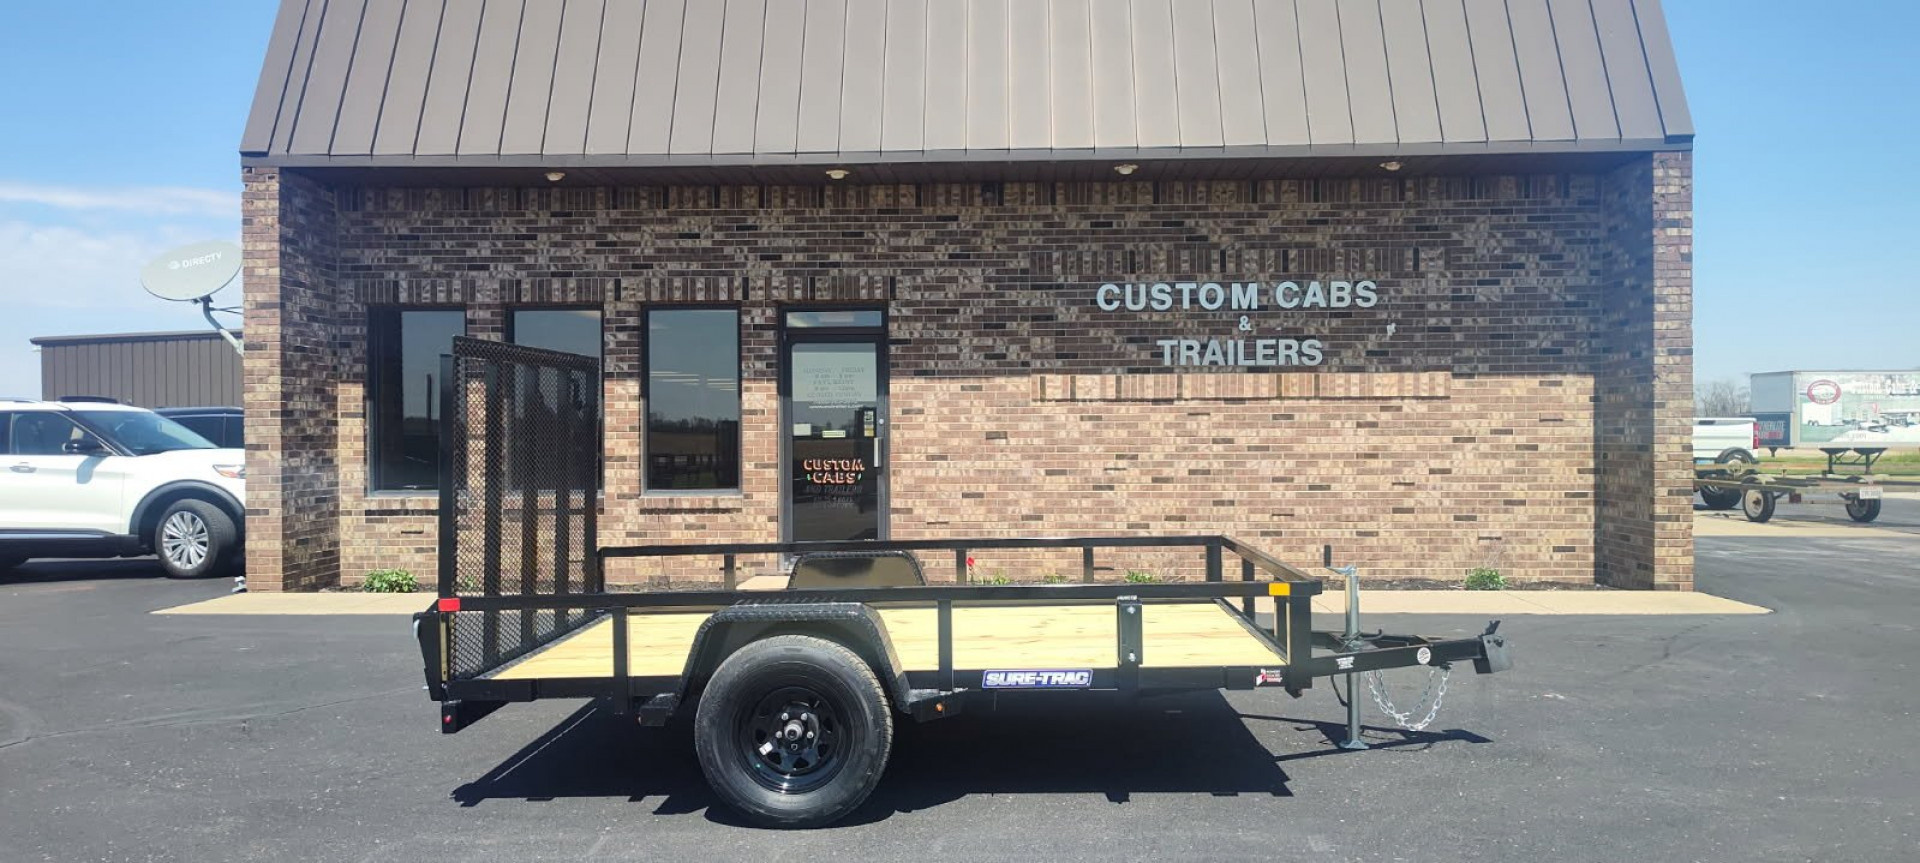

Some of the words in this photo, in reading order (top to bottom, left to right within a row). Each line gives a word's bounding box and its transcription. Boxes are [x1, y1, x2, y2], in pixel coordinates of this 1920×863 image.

[182, 251, 222, 268] DIRECTV
[1096, 283, 1258, 311] CUSTOM
[1275, 280, 1378, 309] CABS
[1238, 315, 1252, 331] &
[1156, 339, 1323, 367] TRAILERS
[803, 459, 865, 471] CUSTOM
[813, 472, 856, 484] CABS
[986, 671, 1089, 686] SURE-TRAC
